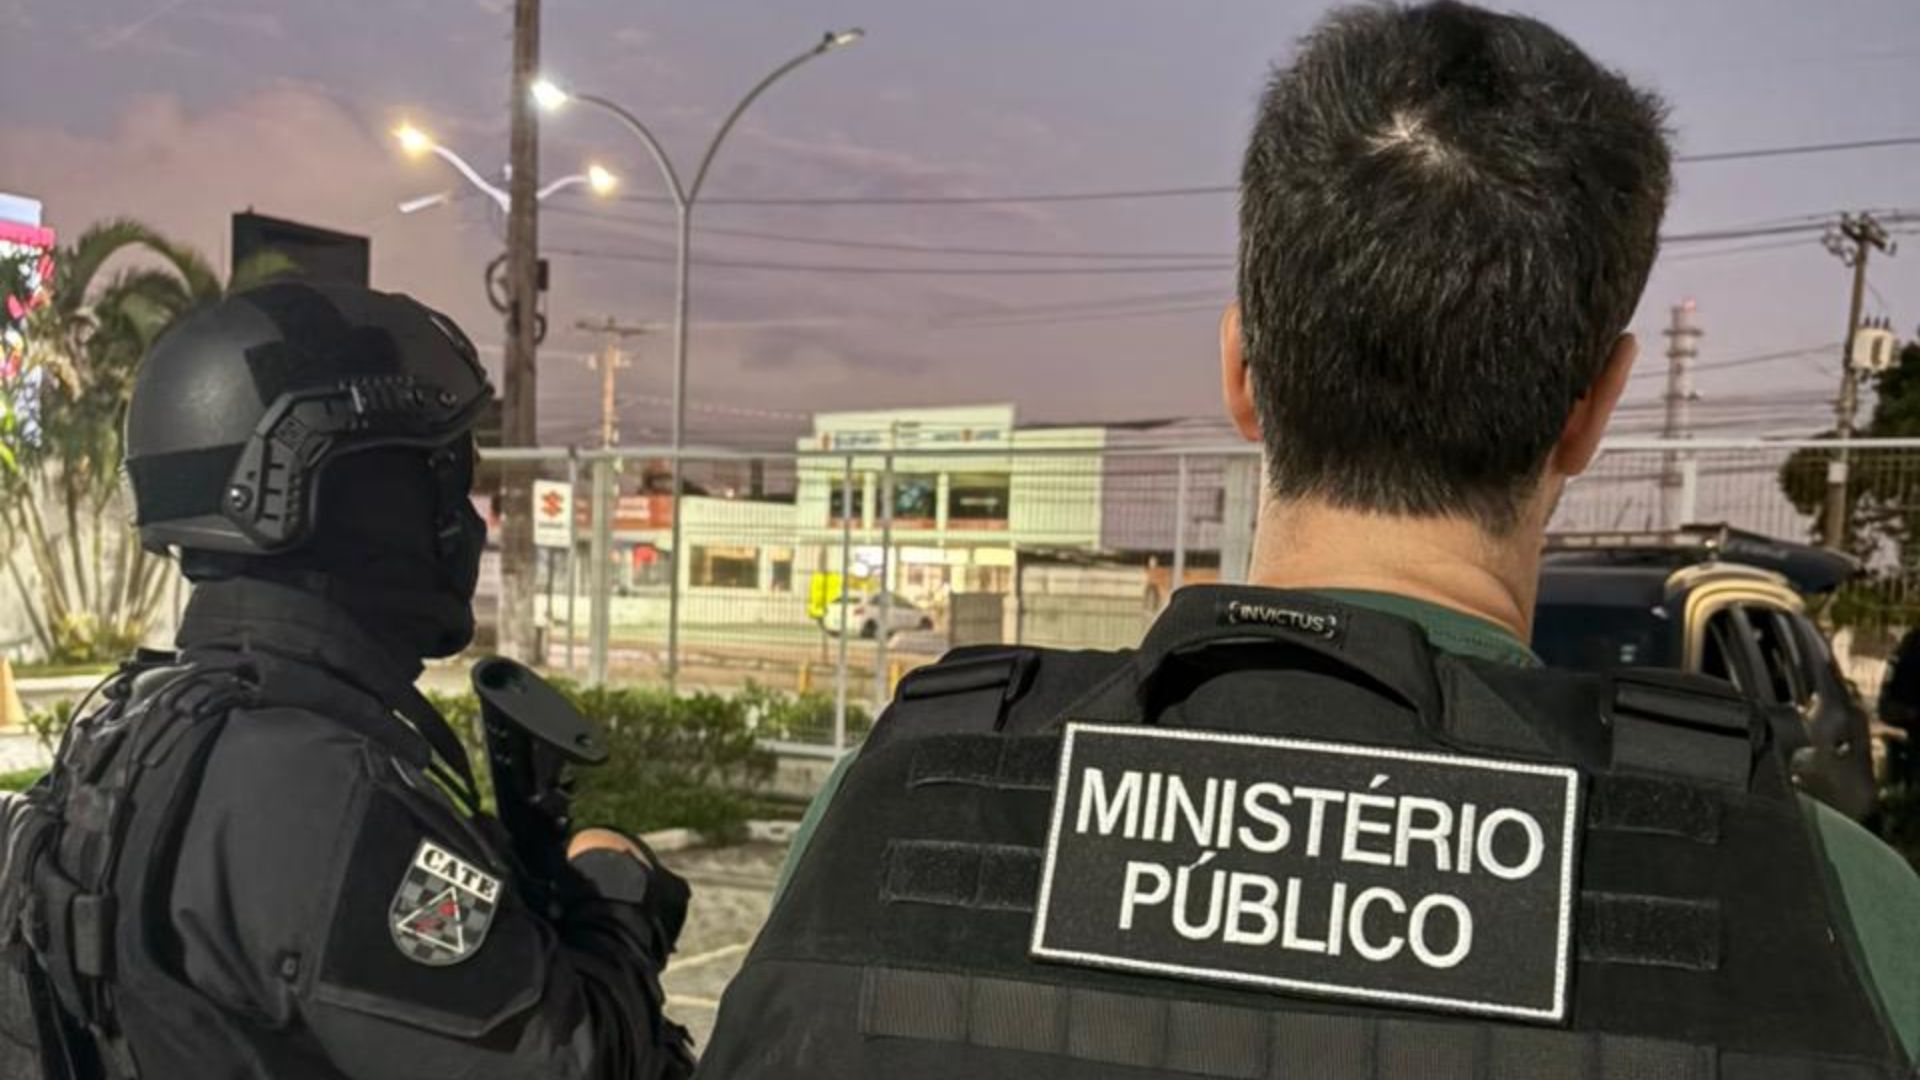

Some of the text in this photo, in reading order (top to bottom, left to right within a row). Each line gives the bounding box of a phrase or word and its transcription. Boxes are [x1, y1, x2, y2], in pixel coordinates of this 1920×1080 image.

[424, 848, 495, 896] CATE
[1075, 768, 1544, 879] MINISTÉRIO
[1119, 852, 1473, 968] PÚBLICO
